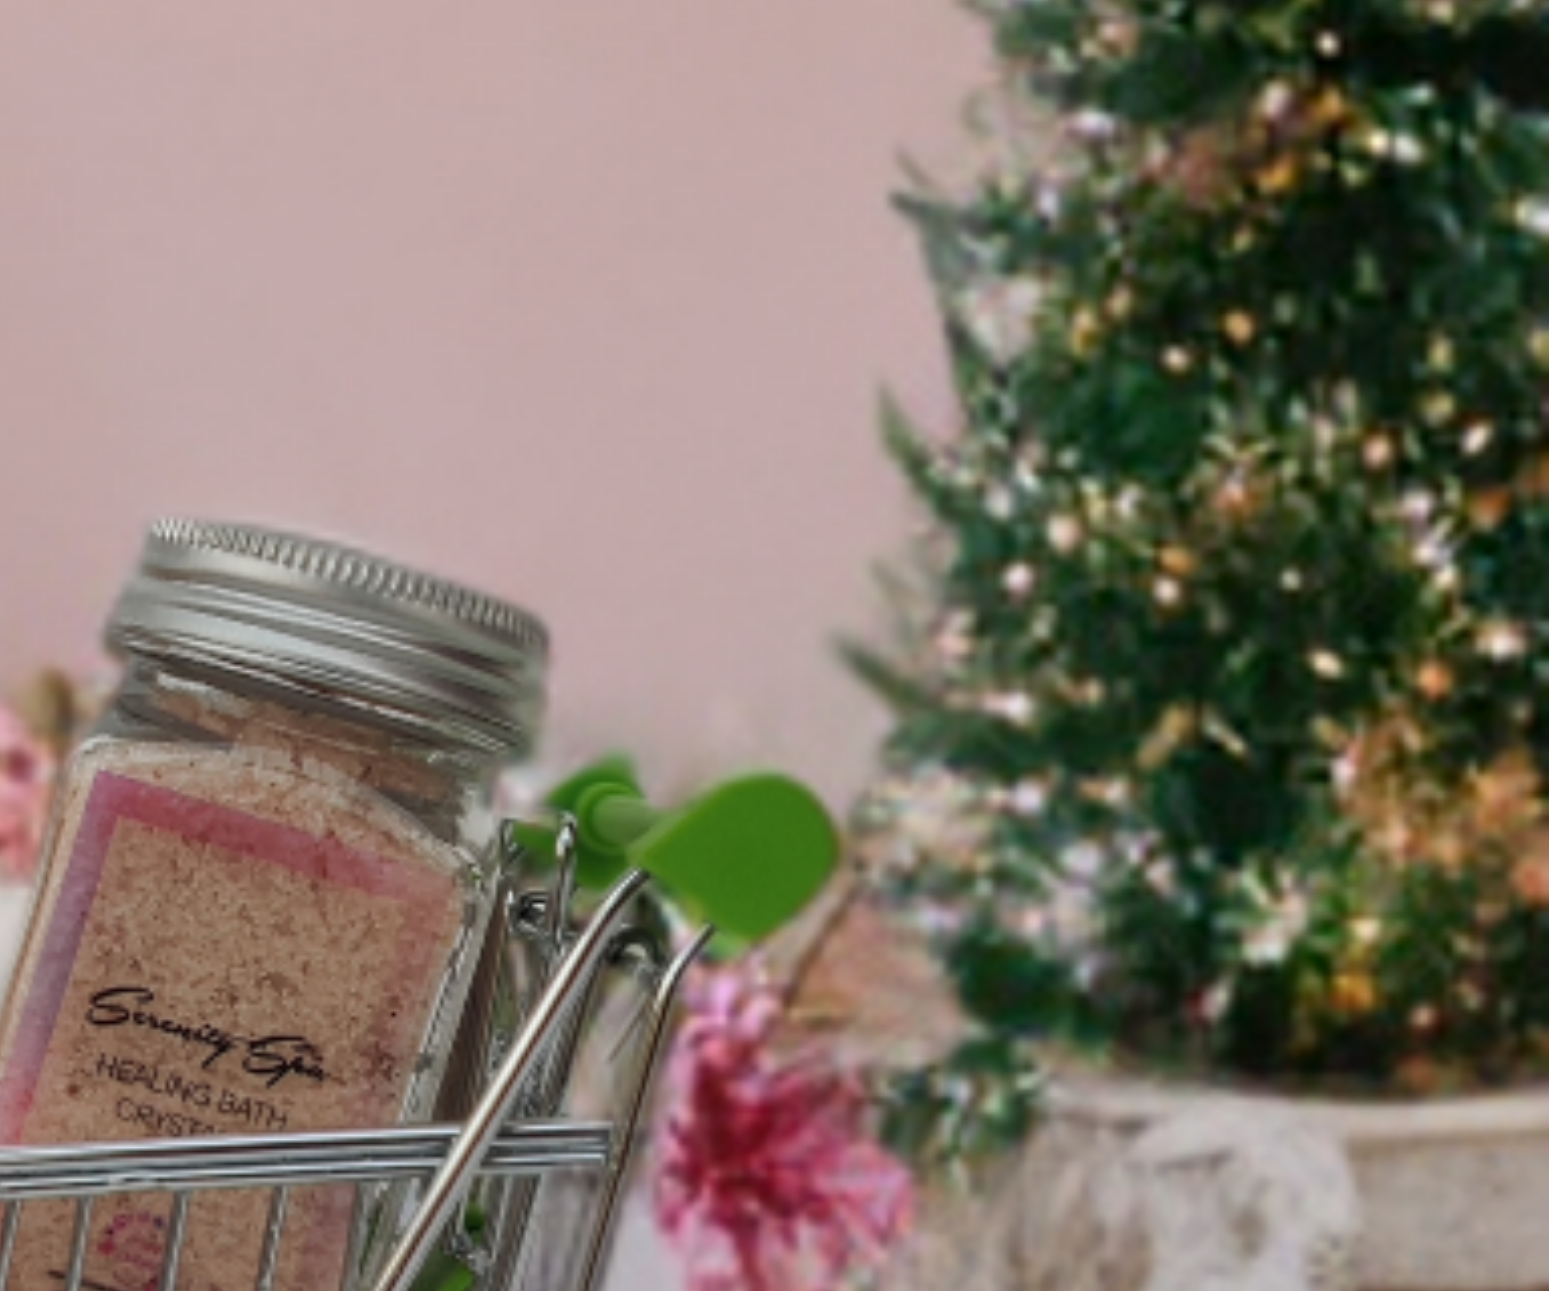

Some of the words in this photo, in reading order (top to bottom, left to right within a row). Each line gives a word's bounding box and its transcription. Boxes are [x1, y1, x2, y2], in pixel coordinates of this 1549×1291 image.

[85, 986, 235, 1070] Serenity
[242, 1035, 329, 1089] Spa
[96, 1053, 211, 1107] HEALING
[217, 1089, 288, 1131] BATH
